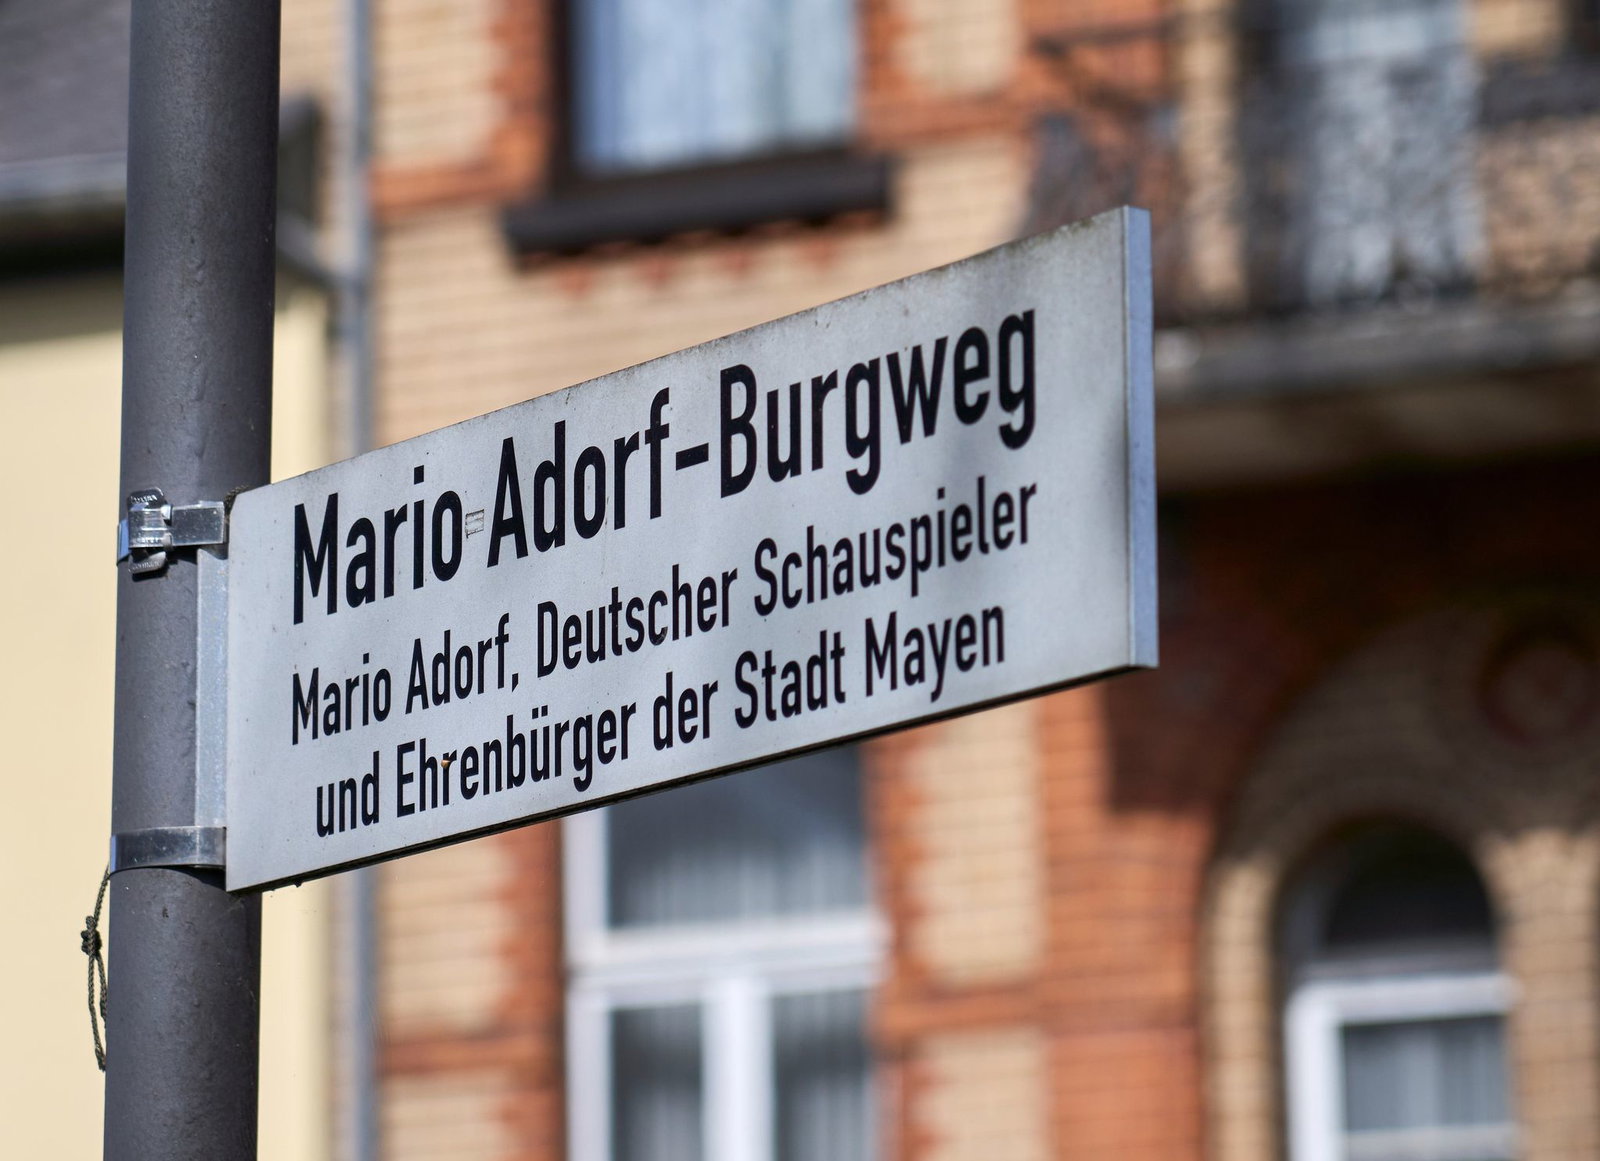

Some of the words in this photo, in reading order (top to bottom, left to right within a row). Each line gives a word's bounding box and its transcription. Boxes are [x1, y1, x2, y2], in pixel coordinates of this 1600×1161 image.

[292, 653, 392, 746] Mario
[406, 613, 519, 715] Adorf,
[538, 564, 738, 679] Deutscher
[754, 484, 1037, 617] Schauspieler
[316, 751, 380, 838] und
[397, 702, 637, 818] Ehrenbürger
[654, 672, 719, 751] der
[735, 630, 846, 729] Stadt
[866, 607, 1005, 703] Mayen
